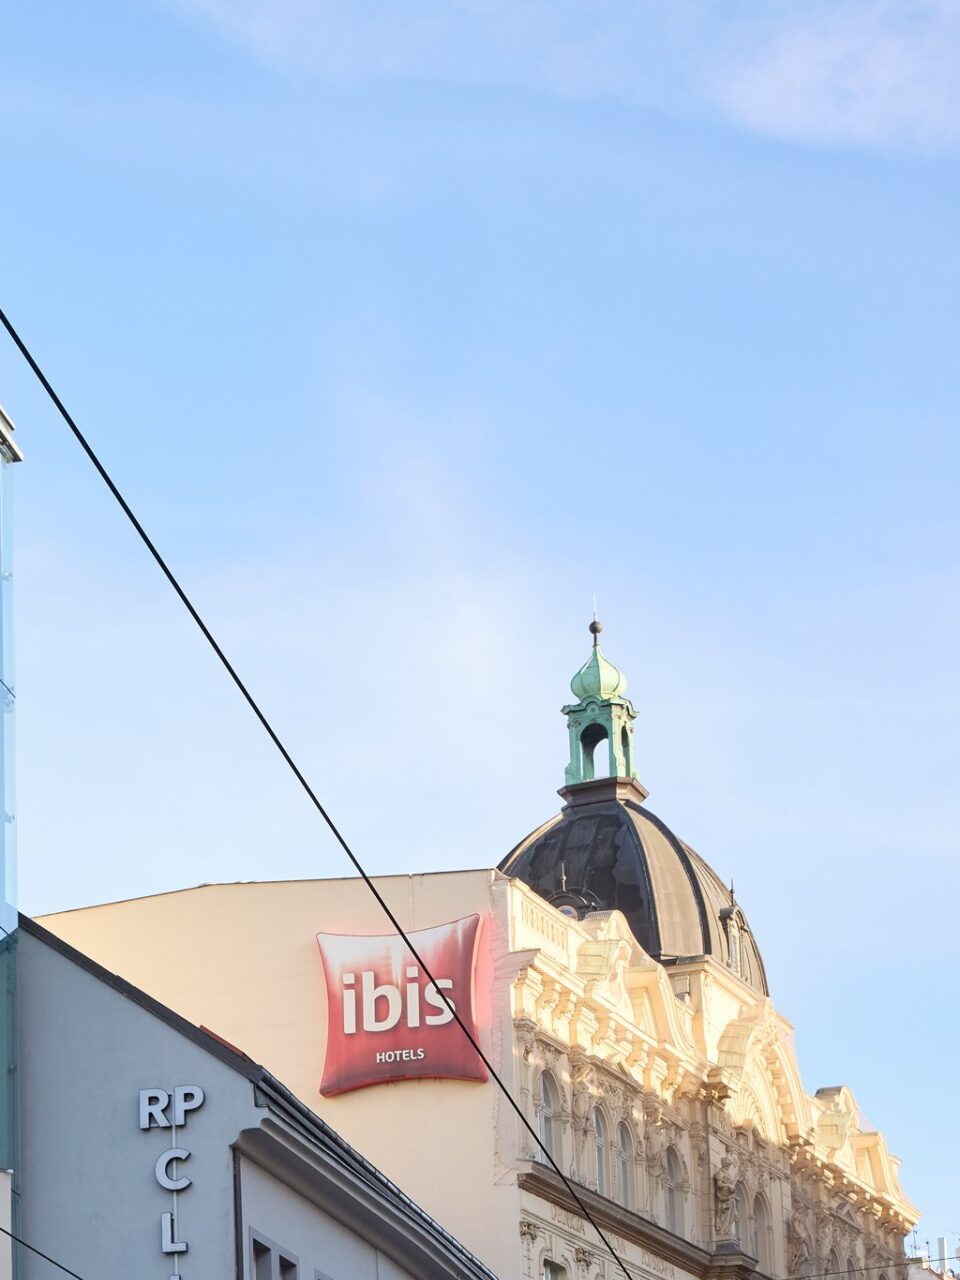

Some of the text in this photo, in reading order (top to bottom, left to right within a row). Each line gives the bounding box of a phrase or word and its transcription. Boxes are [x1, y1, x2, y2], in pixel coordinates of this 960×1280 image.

[342, 965, 456, 1035] ibis
[376, 1048, 425, 1063] HOTELS
[139, 1084, 205, 1131] RP
